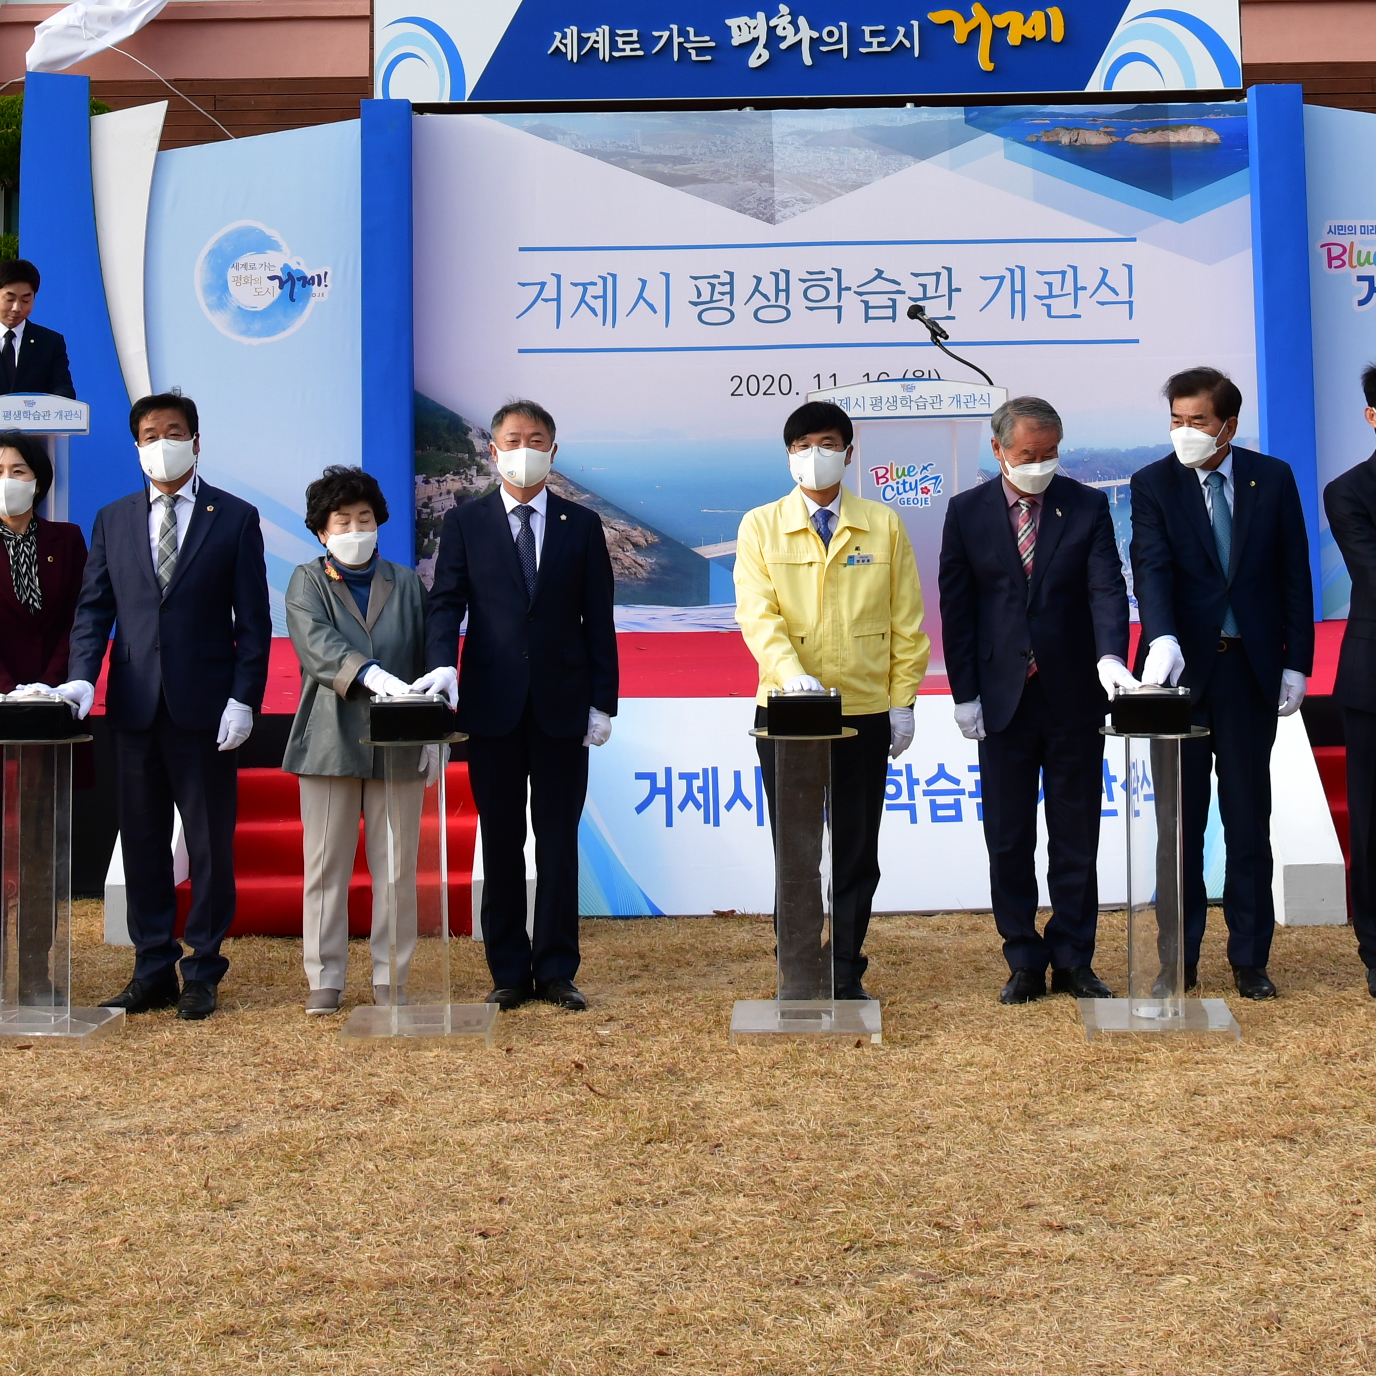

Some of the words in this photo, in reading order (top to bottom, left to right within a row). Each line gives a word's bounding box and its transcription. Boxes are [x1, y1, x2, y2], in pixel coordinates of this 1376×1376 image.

[547, 25, 645, 64] 세계로
[651, 24, 716, 62] 가는
[724, 3, 849, 68] 평화의
[858, 19, 921, 59] 도시
[926, 1, 1065, 72] 거제
[1327, 224, 1357, 235] 시민의
[230, 262, 257, 272] 세계로
[259, 261, 277, 272] 가는
[231, 274, 262, 287] 평화의
[252, 286, 275, 298] 도시
[516, 270, 672, 330] 거제시
[688, 266, 962, 327] 평생학습관
[978, 263, 1135, 322] 개관식
[729, 373, 800, 397] 2020.
[869, 394, 944, 413] 평생학습관
[947, 392, 992, 411] 개관식
[2, 409, 52, 421] 평생학습관
[53, 409, 83, 421] 개관식
[869, 461, 919, 486] Blue
[882, 478, 919, 502] City
[898, 497, 930, 507] GEOJE
[632, 765, 767, 829] 거제시
